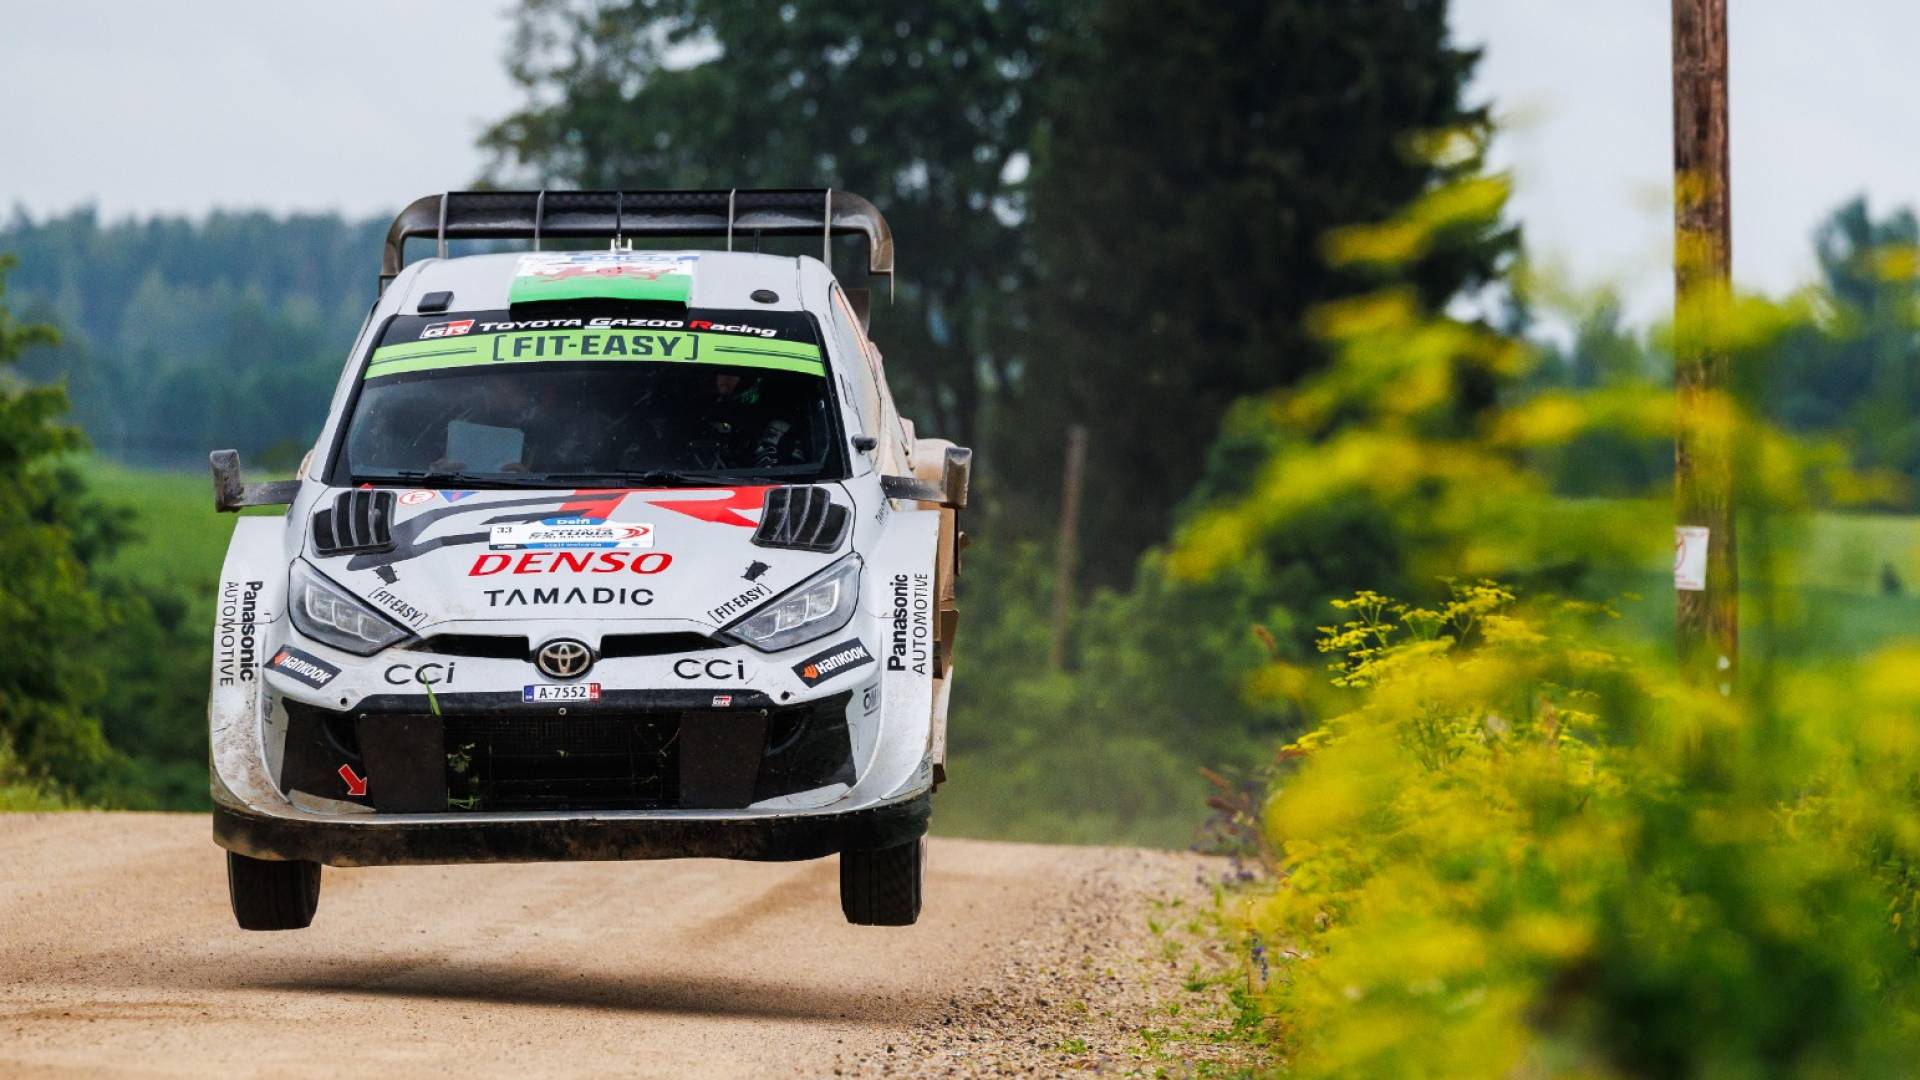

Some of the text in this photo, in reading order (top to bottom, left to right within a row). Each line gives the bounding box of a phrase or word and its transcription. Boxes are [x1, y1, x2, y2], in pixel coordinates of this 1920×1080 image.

[420, 320, 475, 339] GR
[479, 317, 778, 338] TOYOTA GAZOO Racing
[496, 526, 512, 534] 33
[468, 551, 673, 577] DENSO
[484, 587, 655, 607] TAMADIC
[219, 581, 239, 687] AUTOMOTIVE
[239, 580, 264, 682] Panasonic
[887, 574, 908, 672] Panasonic
[912, 573, 928, 676] AUTOMOTIVE
[538, 686, 586, 698] A-7552
